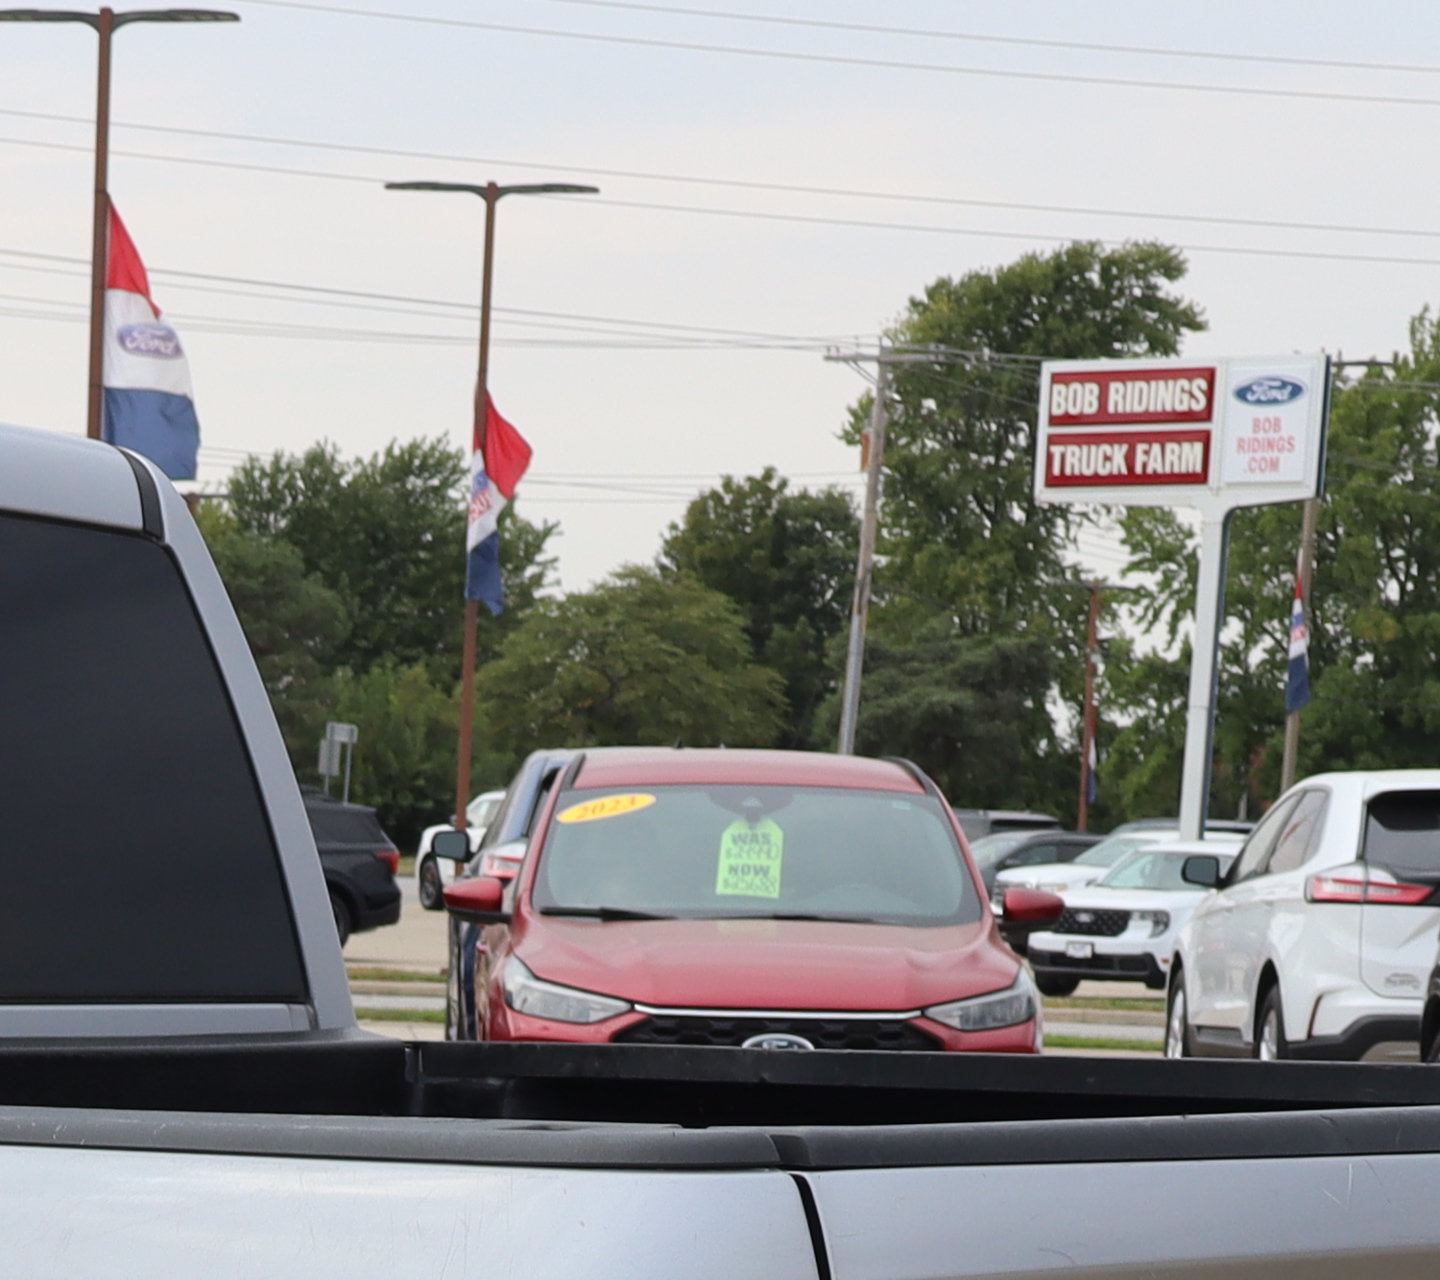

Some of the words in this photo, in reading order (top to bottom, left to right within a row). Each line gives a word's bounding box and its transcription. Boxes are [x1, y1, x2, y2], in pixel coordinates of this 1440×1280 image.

[1050, 382, 1101, 416] BOB
[1107, 377, 1209, 414] RIDINGS
[1244, 378, 1294, 403] Ford
[1252, 417, 1282, 434] BOB
[1236, 436, 1296, 454] RIDINGS
[1049, 443, 1128, 477] TRUCK
[1134, 441, 1204, 474] FARM
[1243, 456, 1280, 474] .COM
[730, 832, 772, 846] WAS
[728, 864, 771, 877] NOW
